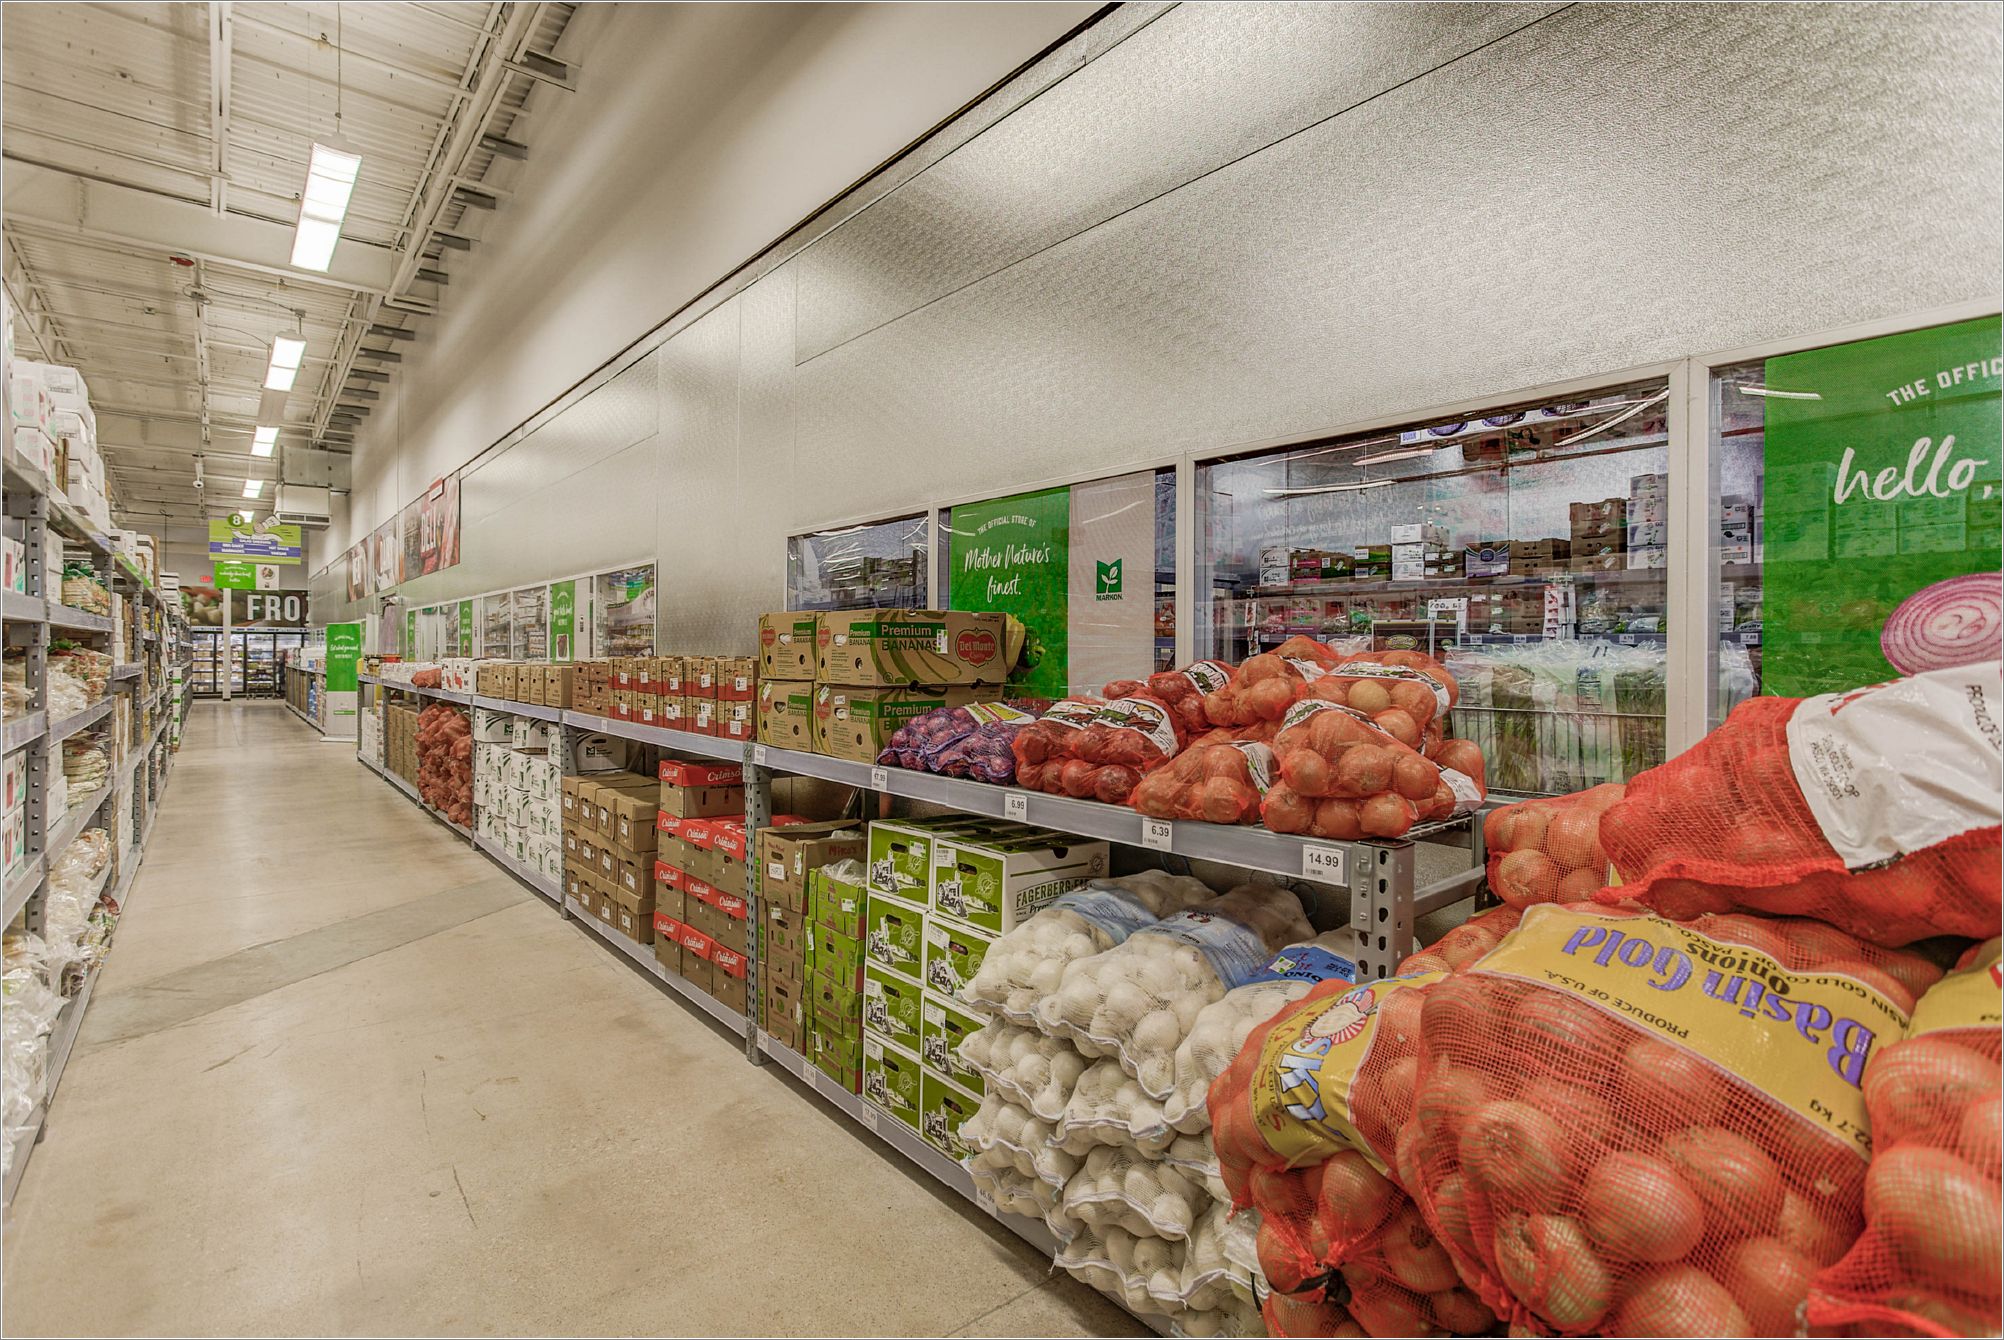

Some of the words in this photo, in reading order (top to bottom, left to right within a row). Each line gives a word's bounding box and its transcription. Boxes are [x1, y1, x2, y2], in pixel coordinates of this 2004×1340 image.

[1886, 378, 1931, 406] THE
[1834, 434, 1993, 504] hello,
[232, 515, 241, 525] 8
[977, 525, 987, 535] THE
[988, 516, 1010, 529] OFFICIAL
[1011, 515, 1028, 525] STORE
[1029, 518, 1036, 528] OF
[964, 546, 1002, 573] Mother
[1004, 541, 1051, 570] Nature's
[986, 573, 1022, 603] finest.
[247, 594, 310, 622] FRO
[881, 624, 932, 636] Premium
[881, 640, 938, 651] BANANAS
[960, 641, 972, 651] Del
[973, 641, 995, 651] Monte
[850, 706, 871, 716] Premium
[883, 704, 932, 717] Premium
[884, 719, 909, 731] BAN
[707, 768, 743, 781] Crimso
[1011, 799, 1025, 810] 6.99
[686, 828, 709, 840] Crimson
[1151, 825, 1170, 837] 6.39
[714, 834, 738, 850] Crimson
[1308, 852, 1339, 867] 14.99
[719, 895, 742, 908] Crimson
[1016, 880, 1071, 908] FAGERBERG
[716, 950, 738, 966] Crimson
[1561, 925, 1693, 992] Gold
[1283, 971, 1324, 983] ONIO
[1686, 942, 1791, 996] Onions
[1544, 968, 1586, 991] U.S.A.
[1816, 976, 1867, 999] GOLD
[1586, 988, 1610, 1001] OF
[1612, 997, 1691, 1040] PRODUCE
[1871, 998, 1909, 1031] ASIN
[1702, 968, 1876, 1091] Basin
[1809, 1098, 1834, 1122] kg
